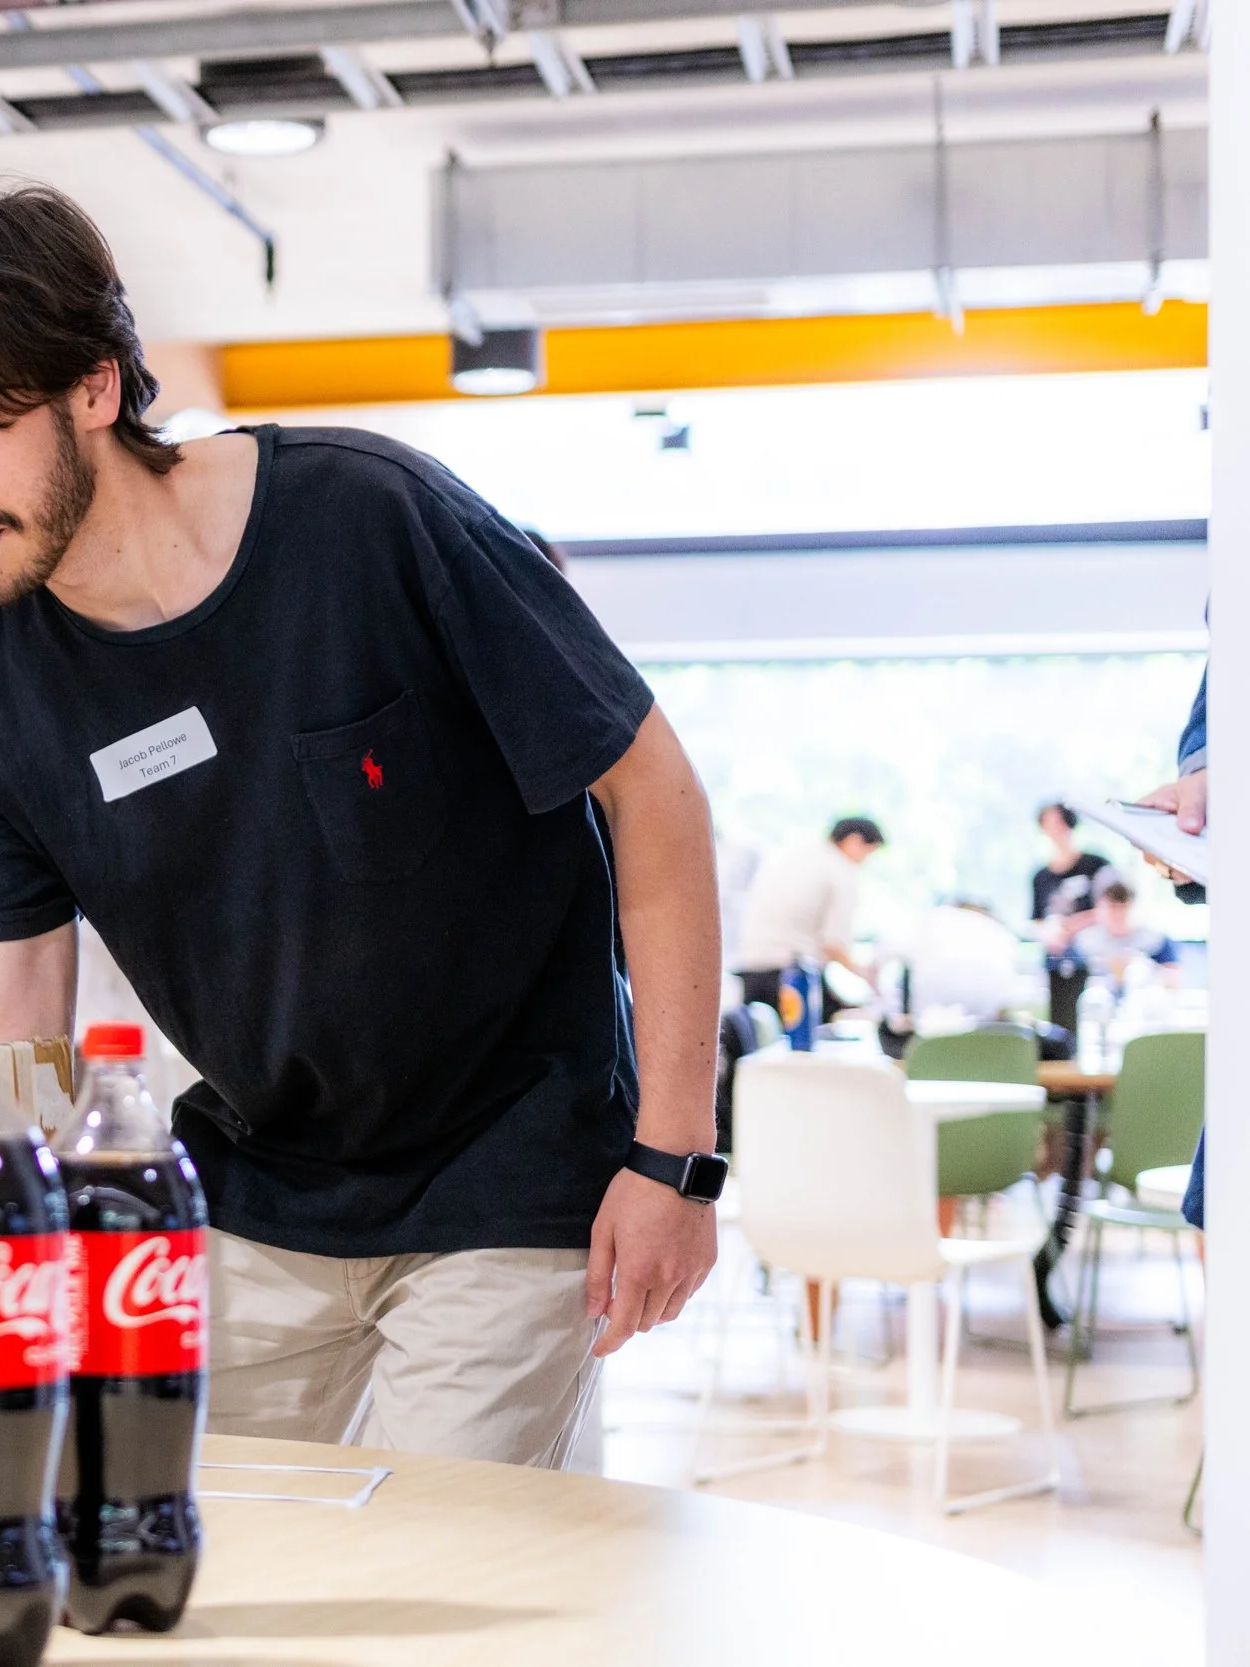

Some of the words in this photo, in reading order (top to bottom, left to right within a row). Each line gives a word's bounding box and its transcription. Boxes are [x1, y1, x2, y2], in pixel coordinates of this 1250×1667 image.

[119, 750, 148, 770] Jacob
[148, 733, 187, 756] Pellowe
[139, 760, 170, 778] Team
[169, 754, 177, 765] 7
